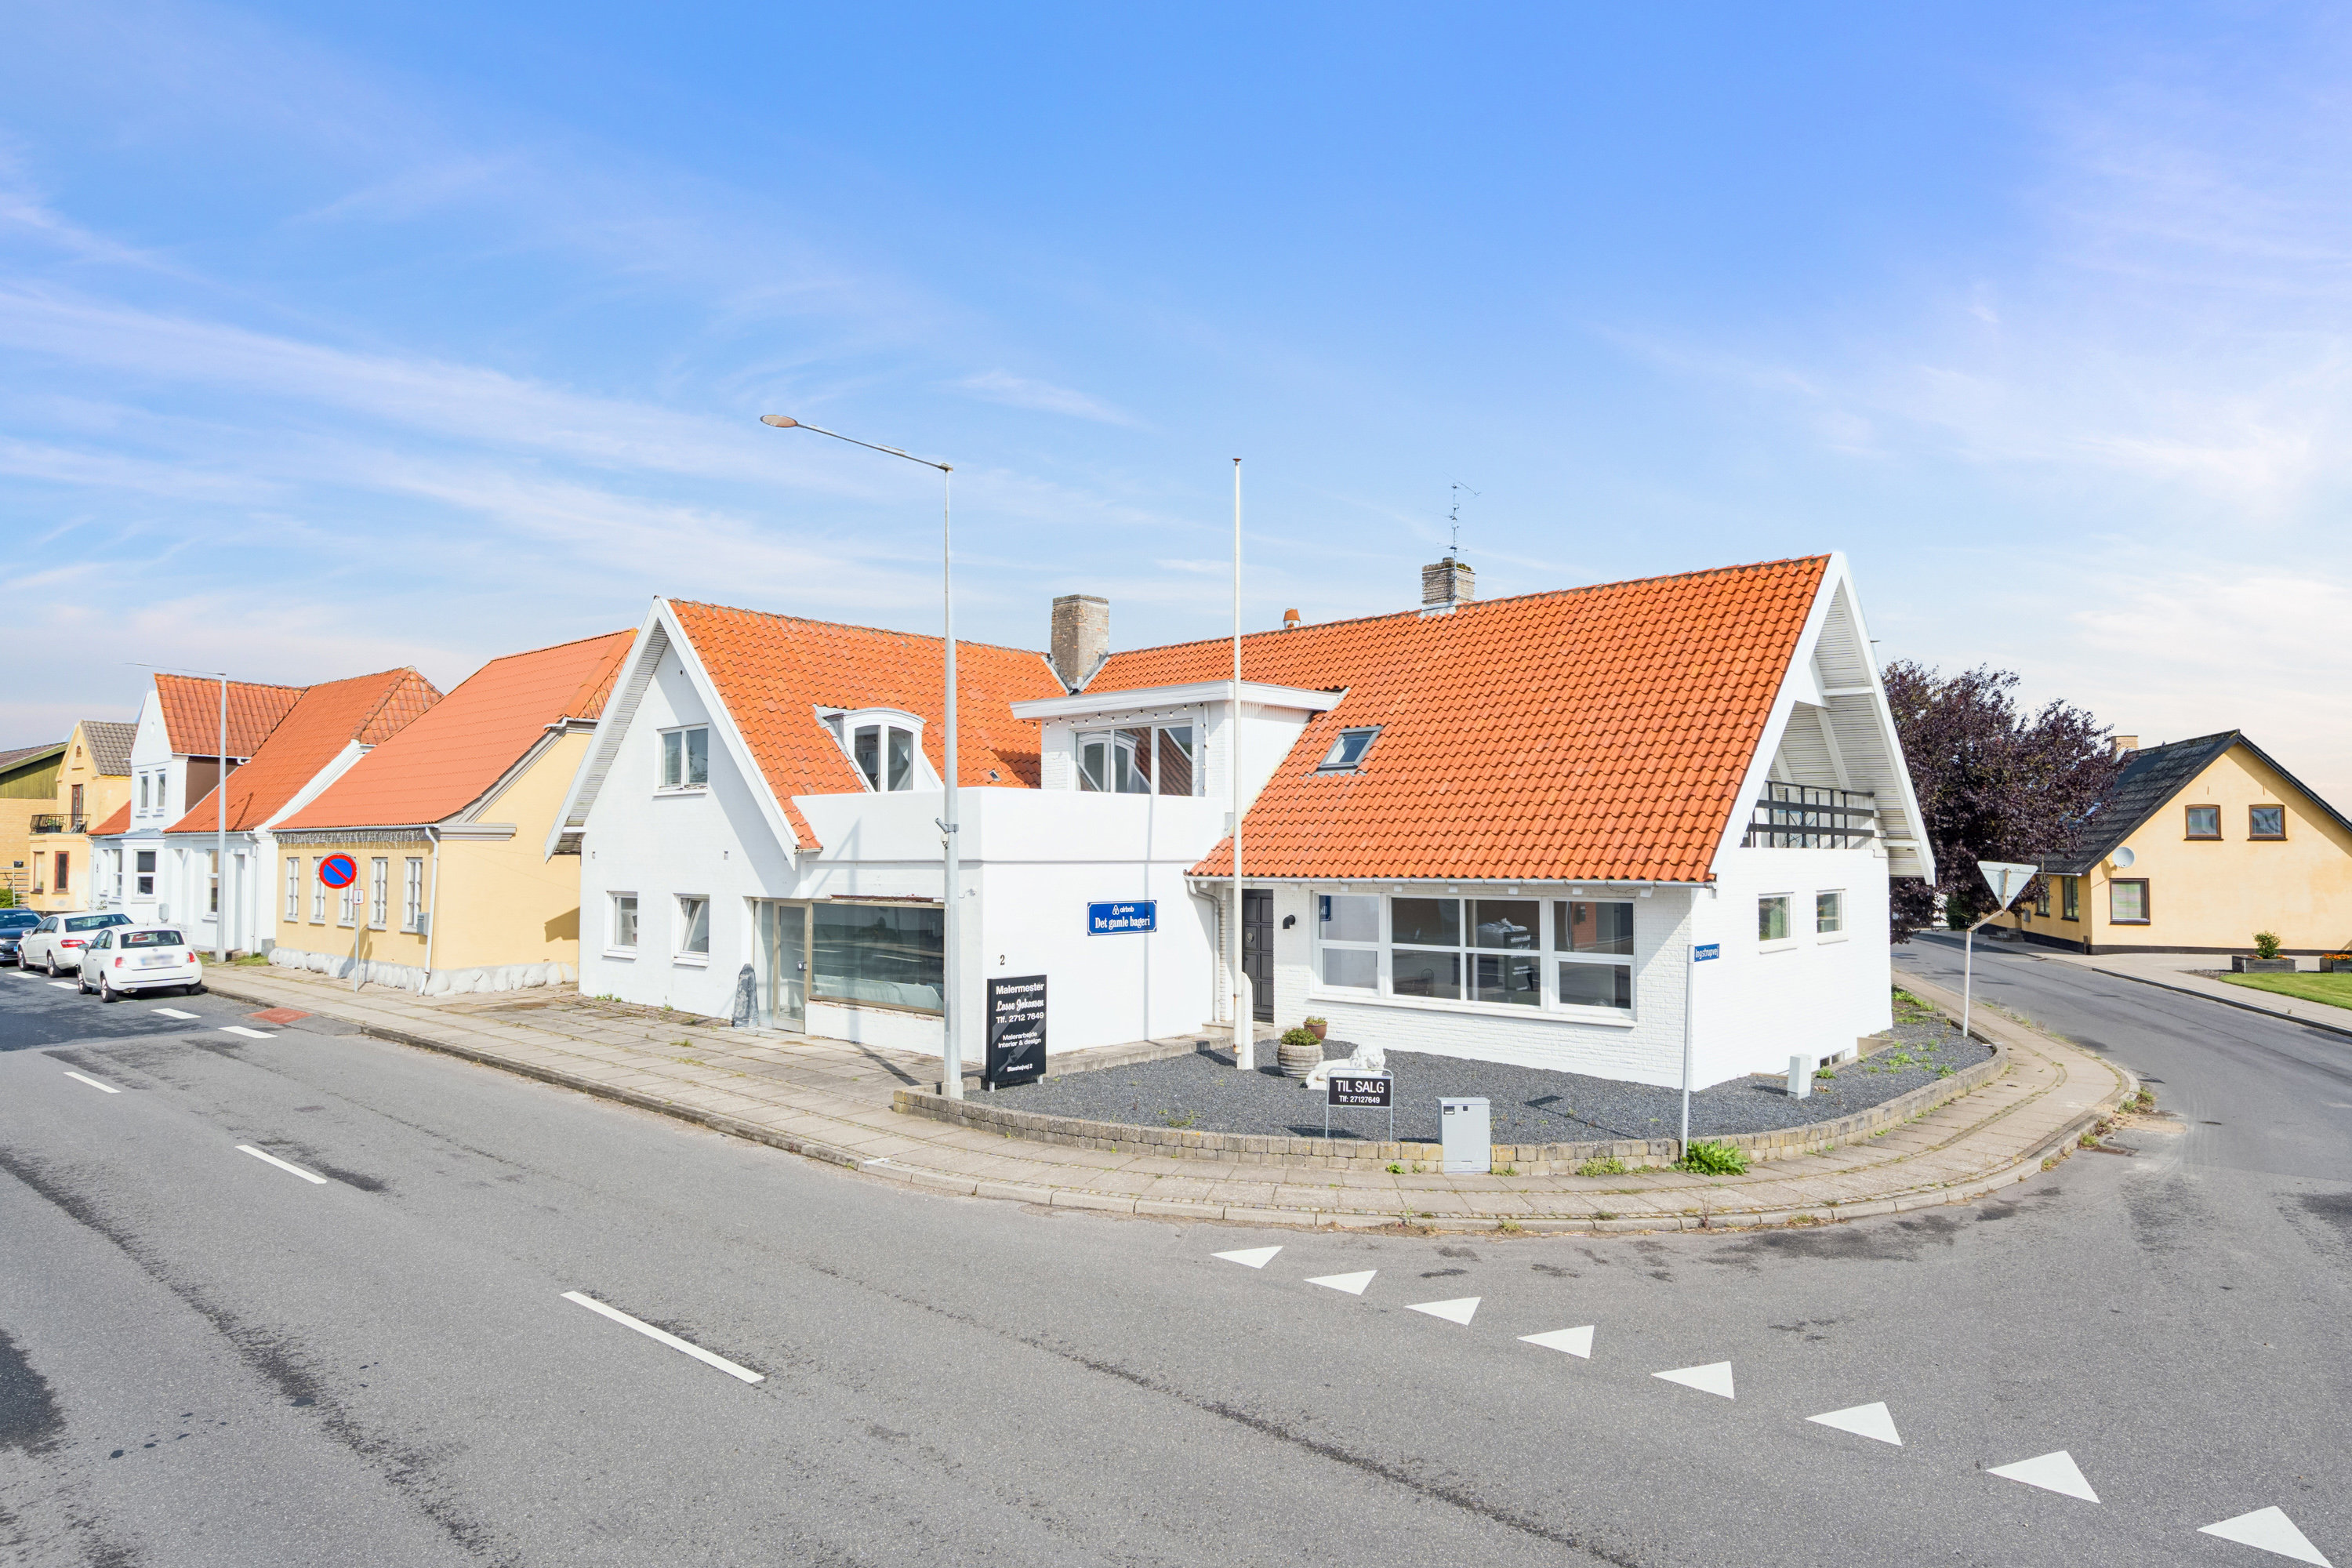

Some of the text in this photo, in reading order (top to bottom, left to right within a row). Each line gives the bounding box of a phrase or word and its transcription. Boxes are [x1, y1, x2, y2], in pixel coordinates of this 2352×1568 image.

[1095, 915, 1150, 930] Det gamle bageri
[1000, 954, 1005, 965] 2
[1695, 946, 1719, 960] Ingstrupvej
[996, 983, 1044, 995] Malermester
[996, 998, 1044, 1012] Lasse Johansen
[1336, 1080, 1385, 1094] TIL SALG
[1339, 1094, 1381, 1104] Tlf: 27127649
